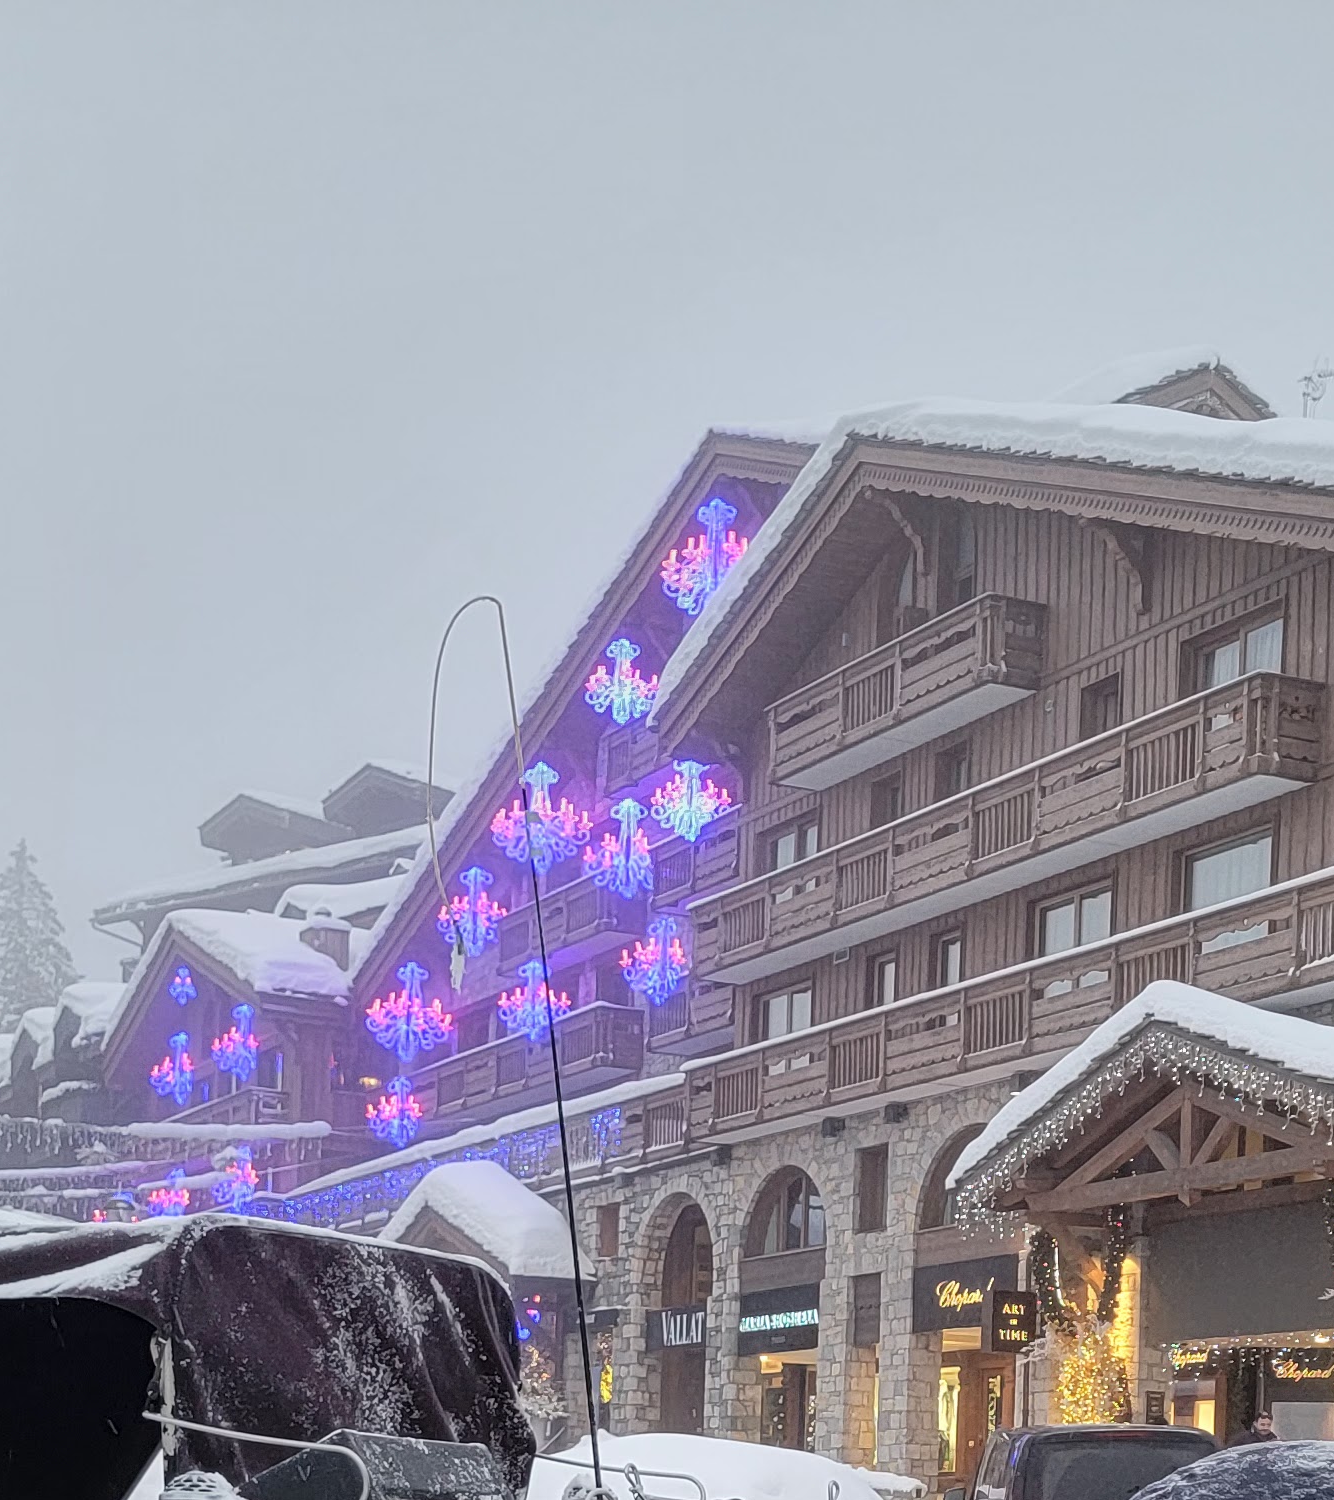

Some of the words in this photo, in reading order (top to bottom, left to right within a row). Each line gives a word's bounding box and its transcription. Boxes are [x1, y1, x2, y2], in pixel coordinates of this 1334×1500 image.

[1002, 1303, 1025, 1315] ART
[661, 1310, 705, 1346] VALLAT
[999, 1329, 1028, 1341] TIME
